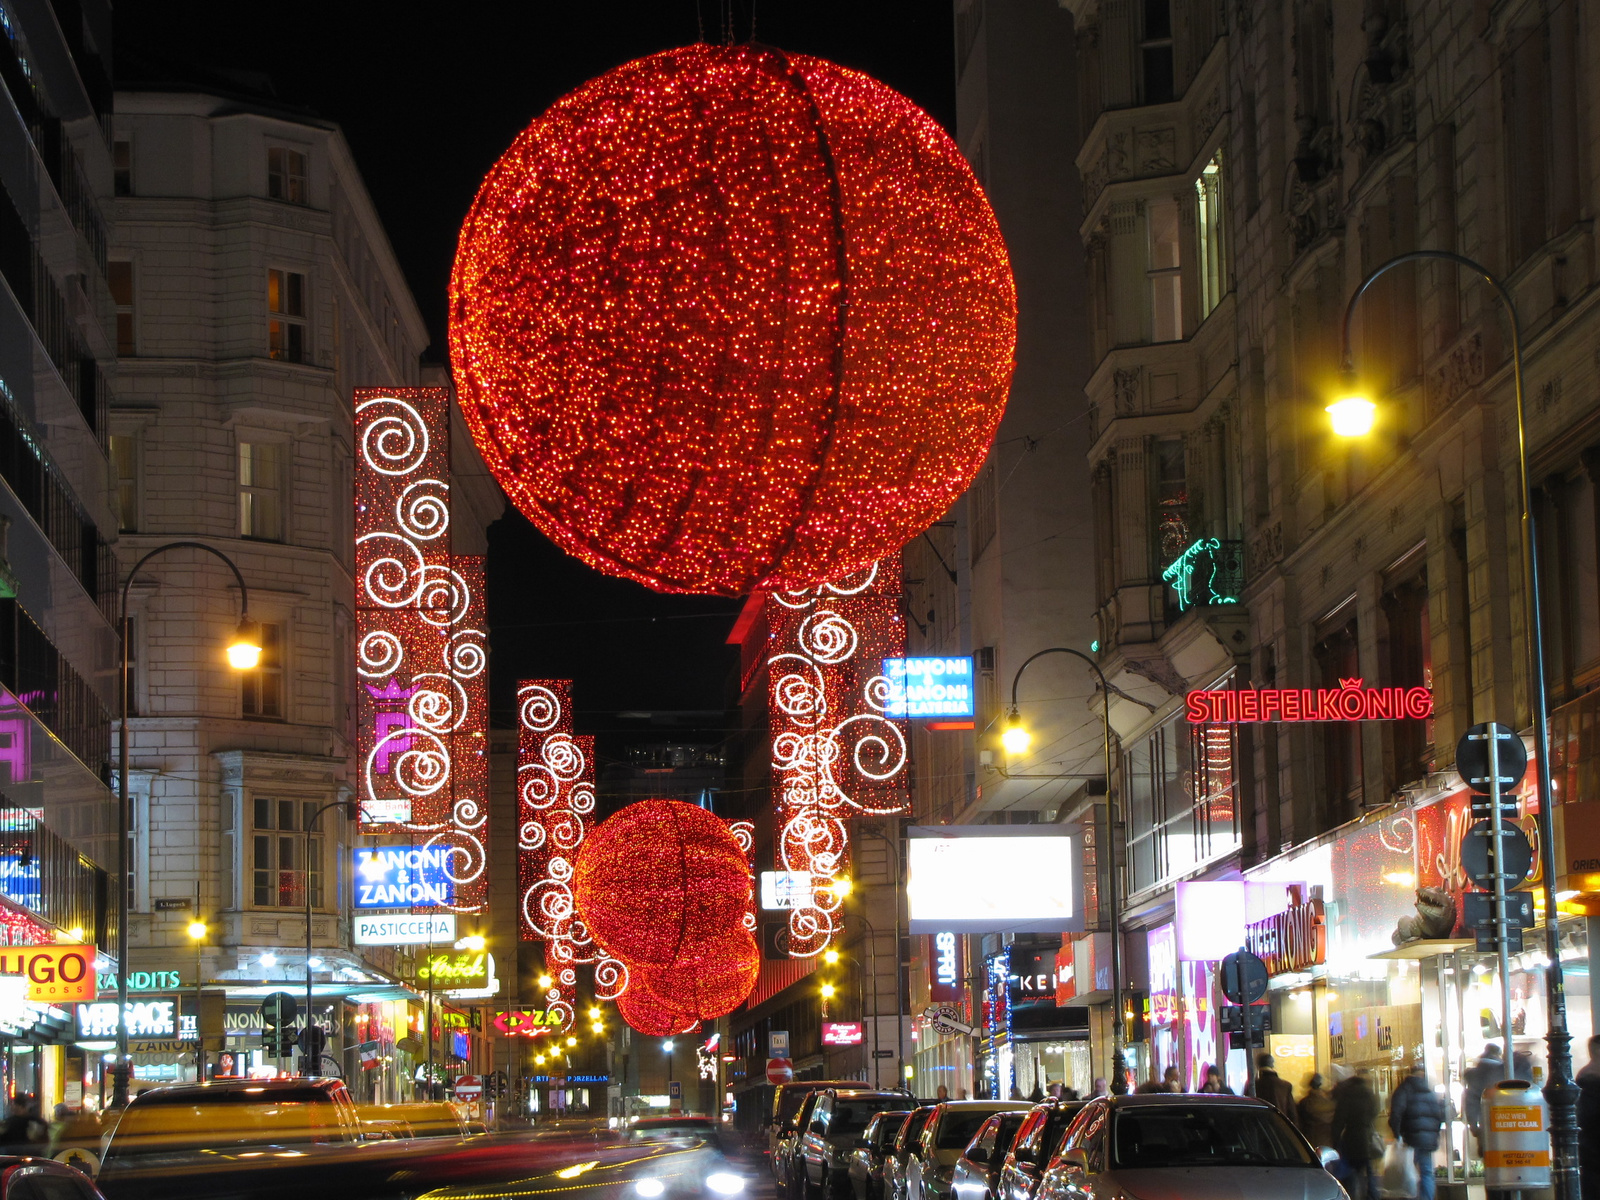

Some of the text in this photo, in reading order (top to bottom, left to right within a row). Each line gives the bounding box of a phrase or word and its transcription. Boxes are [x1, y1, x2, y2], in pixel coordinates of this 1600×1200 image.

[889, 659, 967, 675] ZANONI
[359, 848, 447, 871] ZANONI
[360, 882, 447, 904] ZANONI
[361, 921, 449, 936] PASTICCERIA
[36, 986, 82, 994] BOSS
[81, 1024, 174, 1036] COLLCTION
[773, 1036, 785, 1044] Taxi
